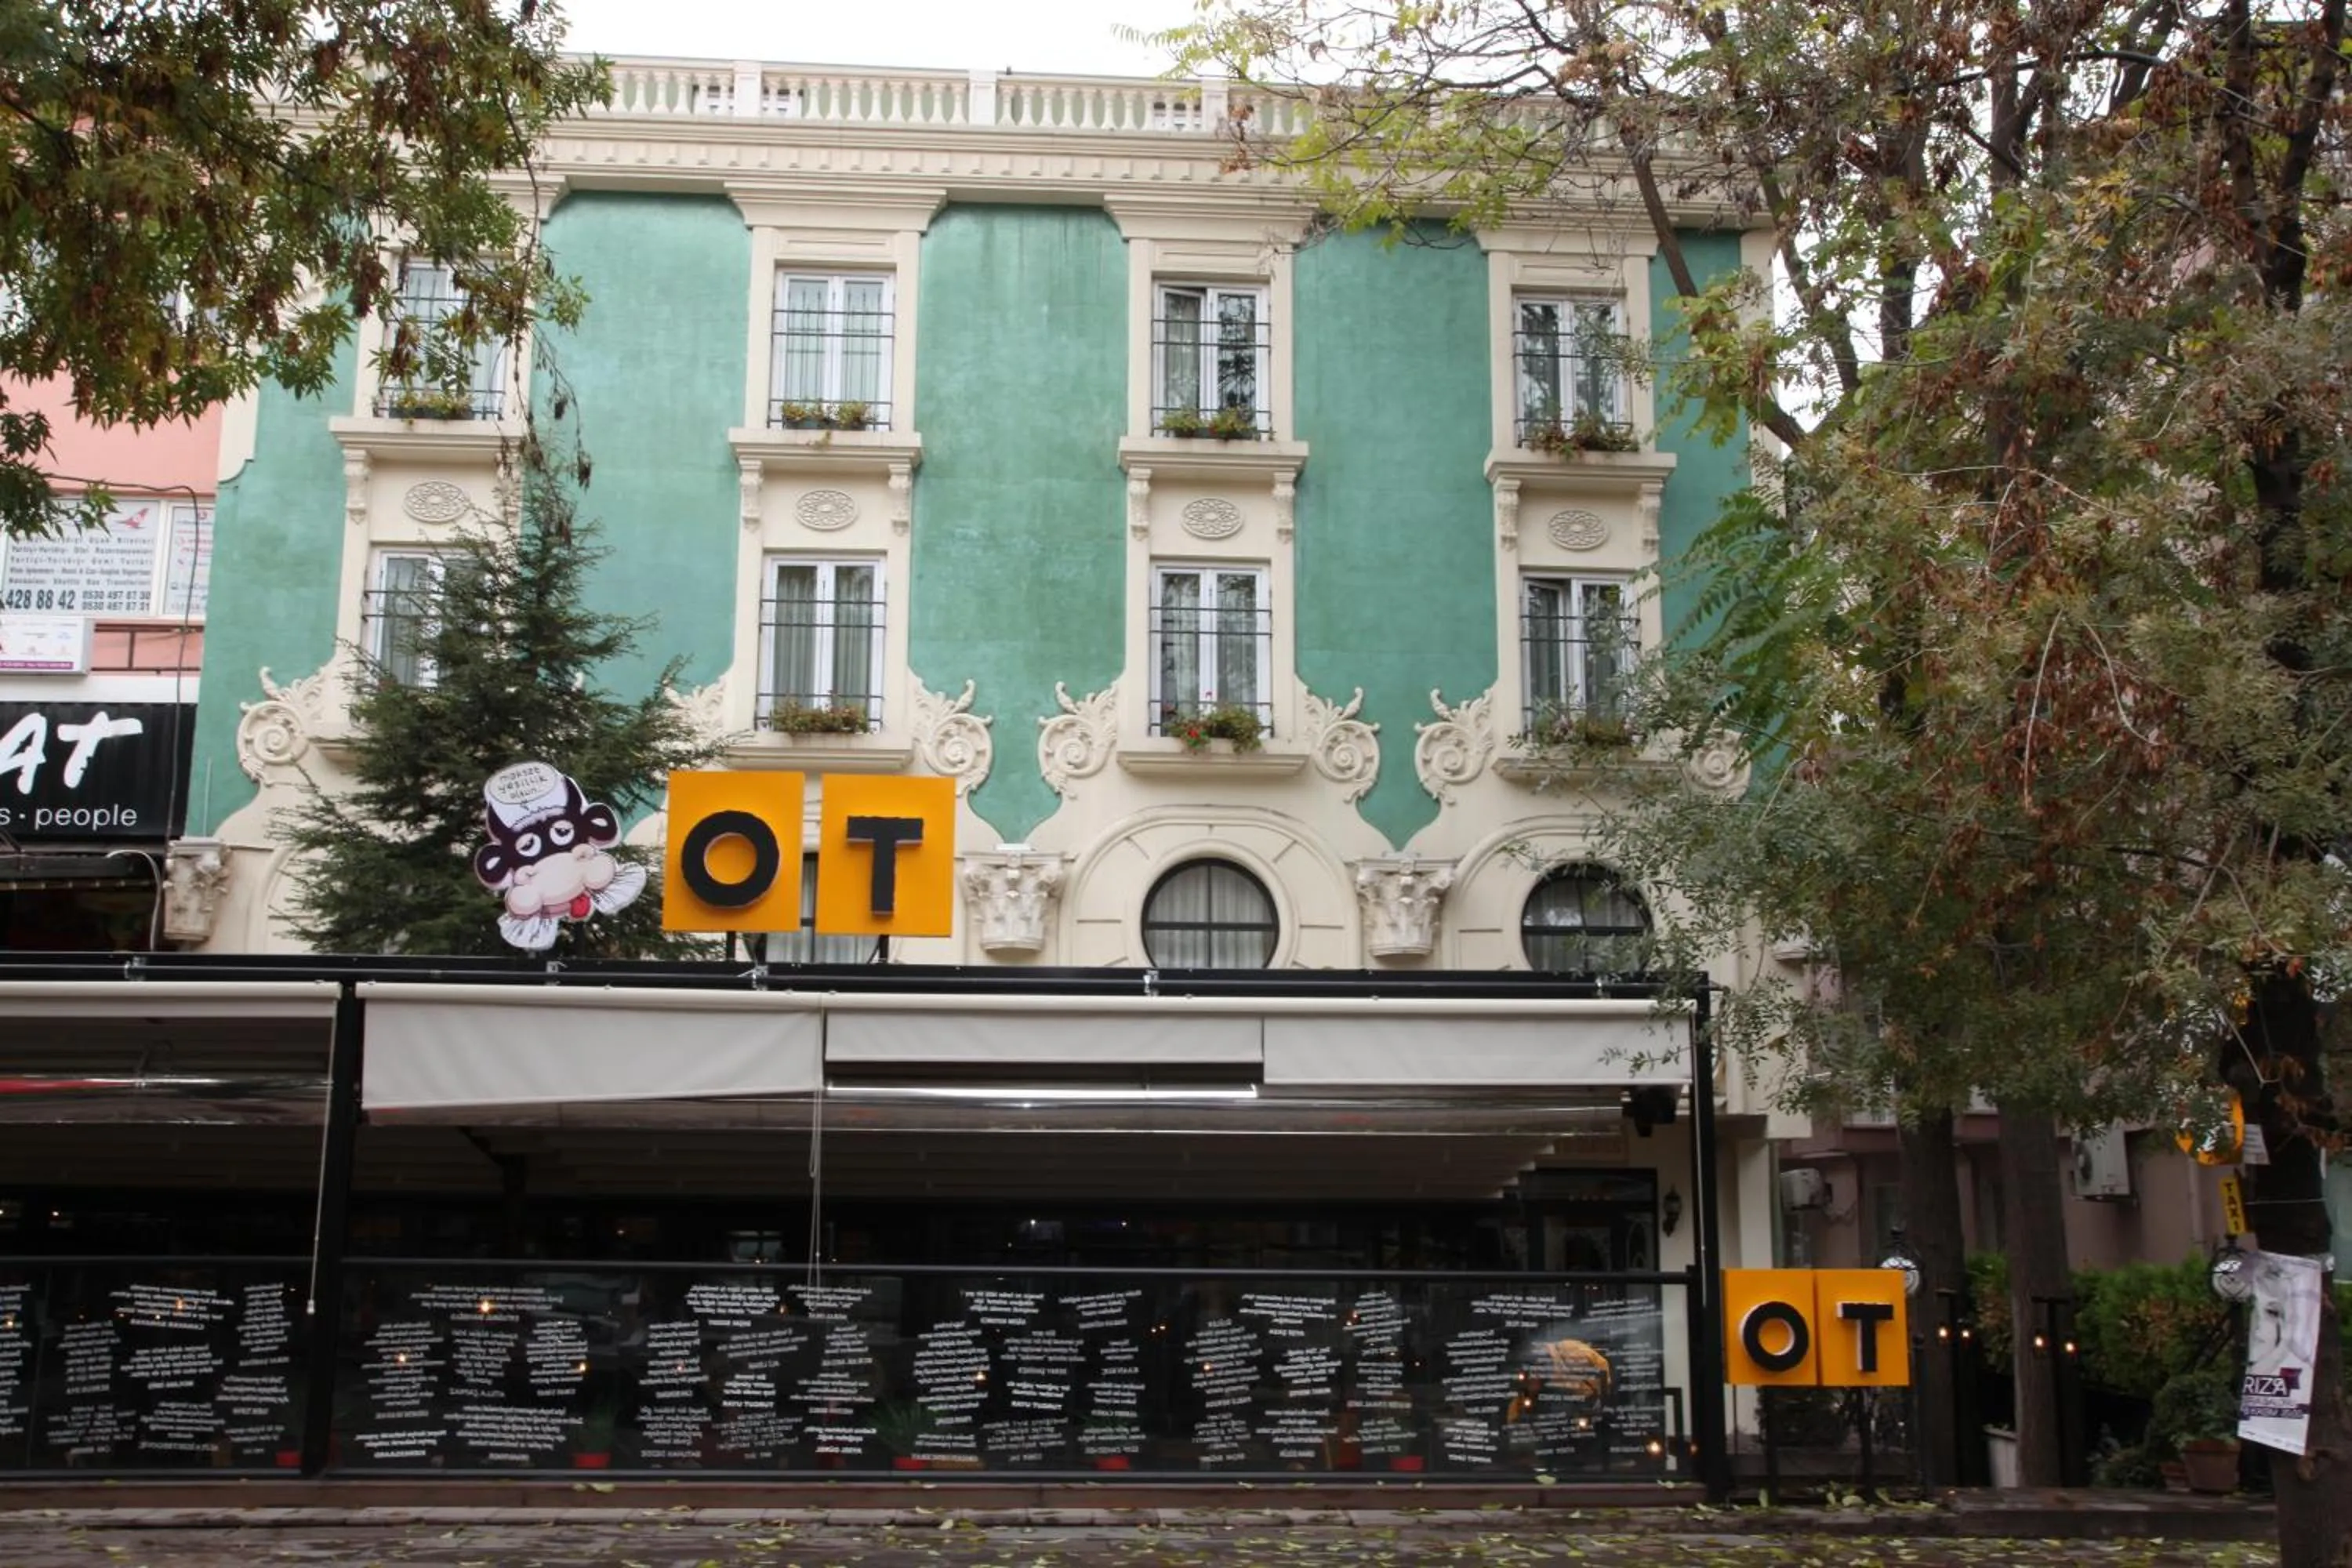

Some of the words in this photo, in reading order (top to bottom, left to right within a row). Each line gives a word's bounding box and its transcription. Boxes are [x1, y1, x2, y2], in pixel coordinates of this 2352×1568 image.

[5, 589, 31, 609] 428
[36, 589, 54, 610] 88
[58, 590, 76, 610] 42
[35, 804, 137, 831] people
[2223, 1181, 2241, 1232] TAXI
